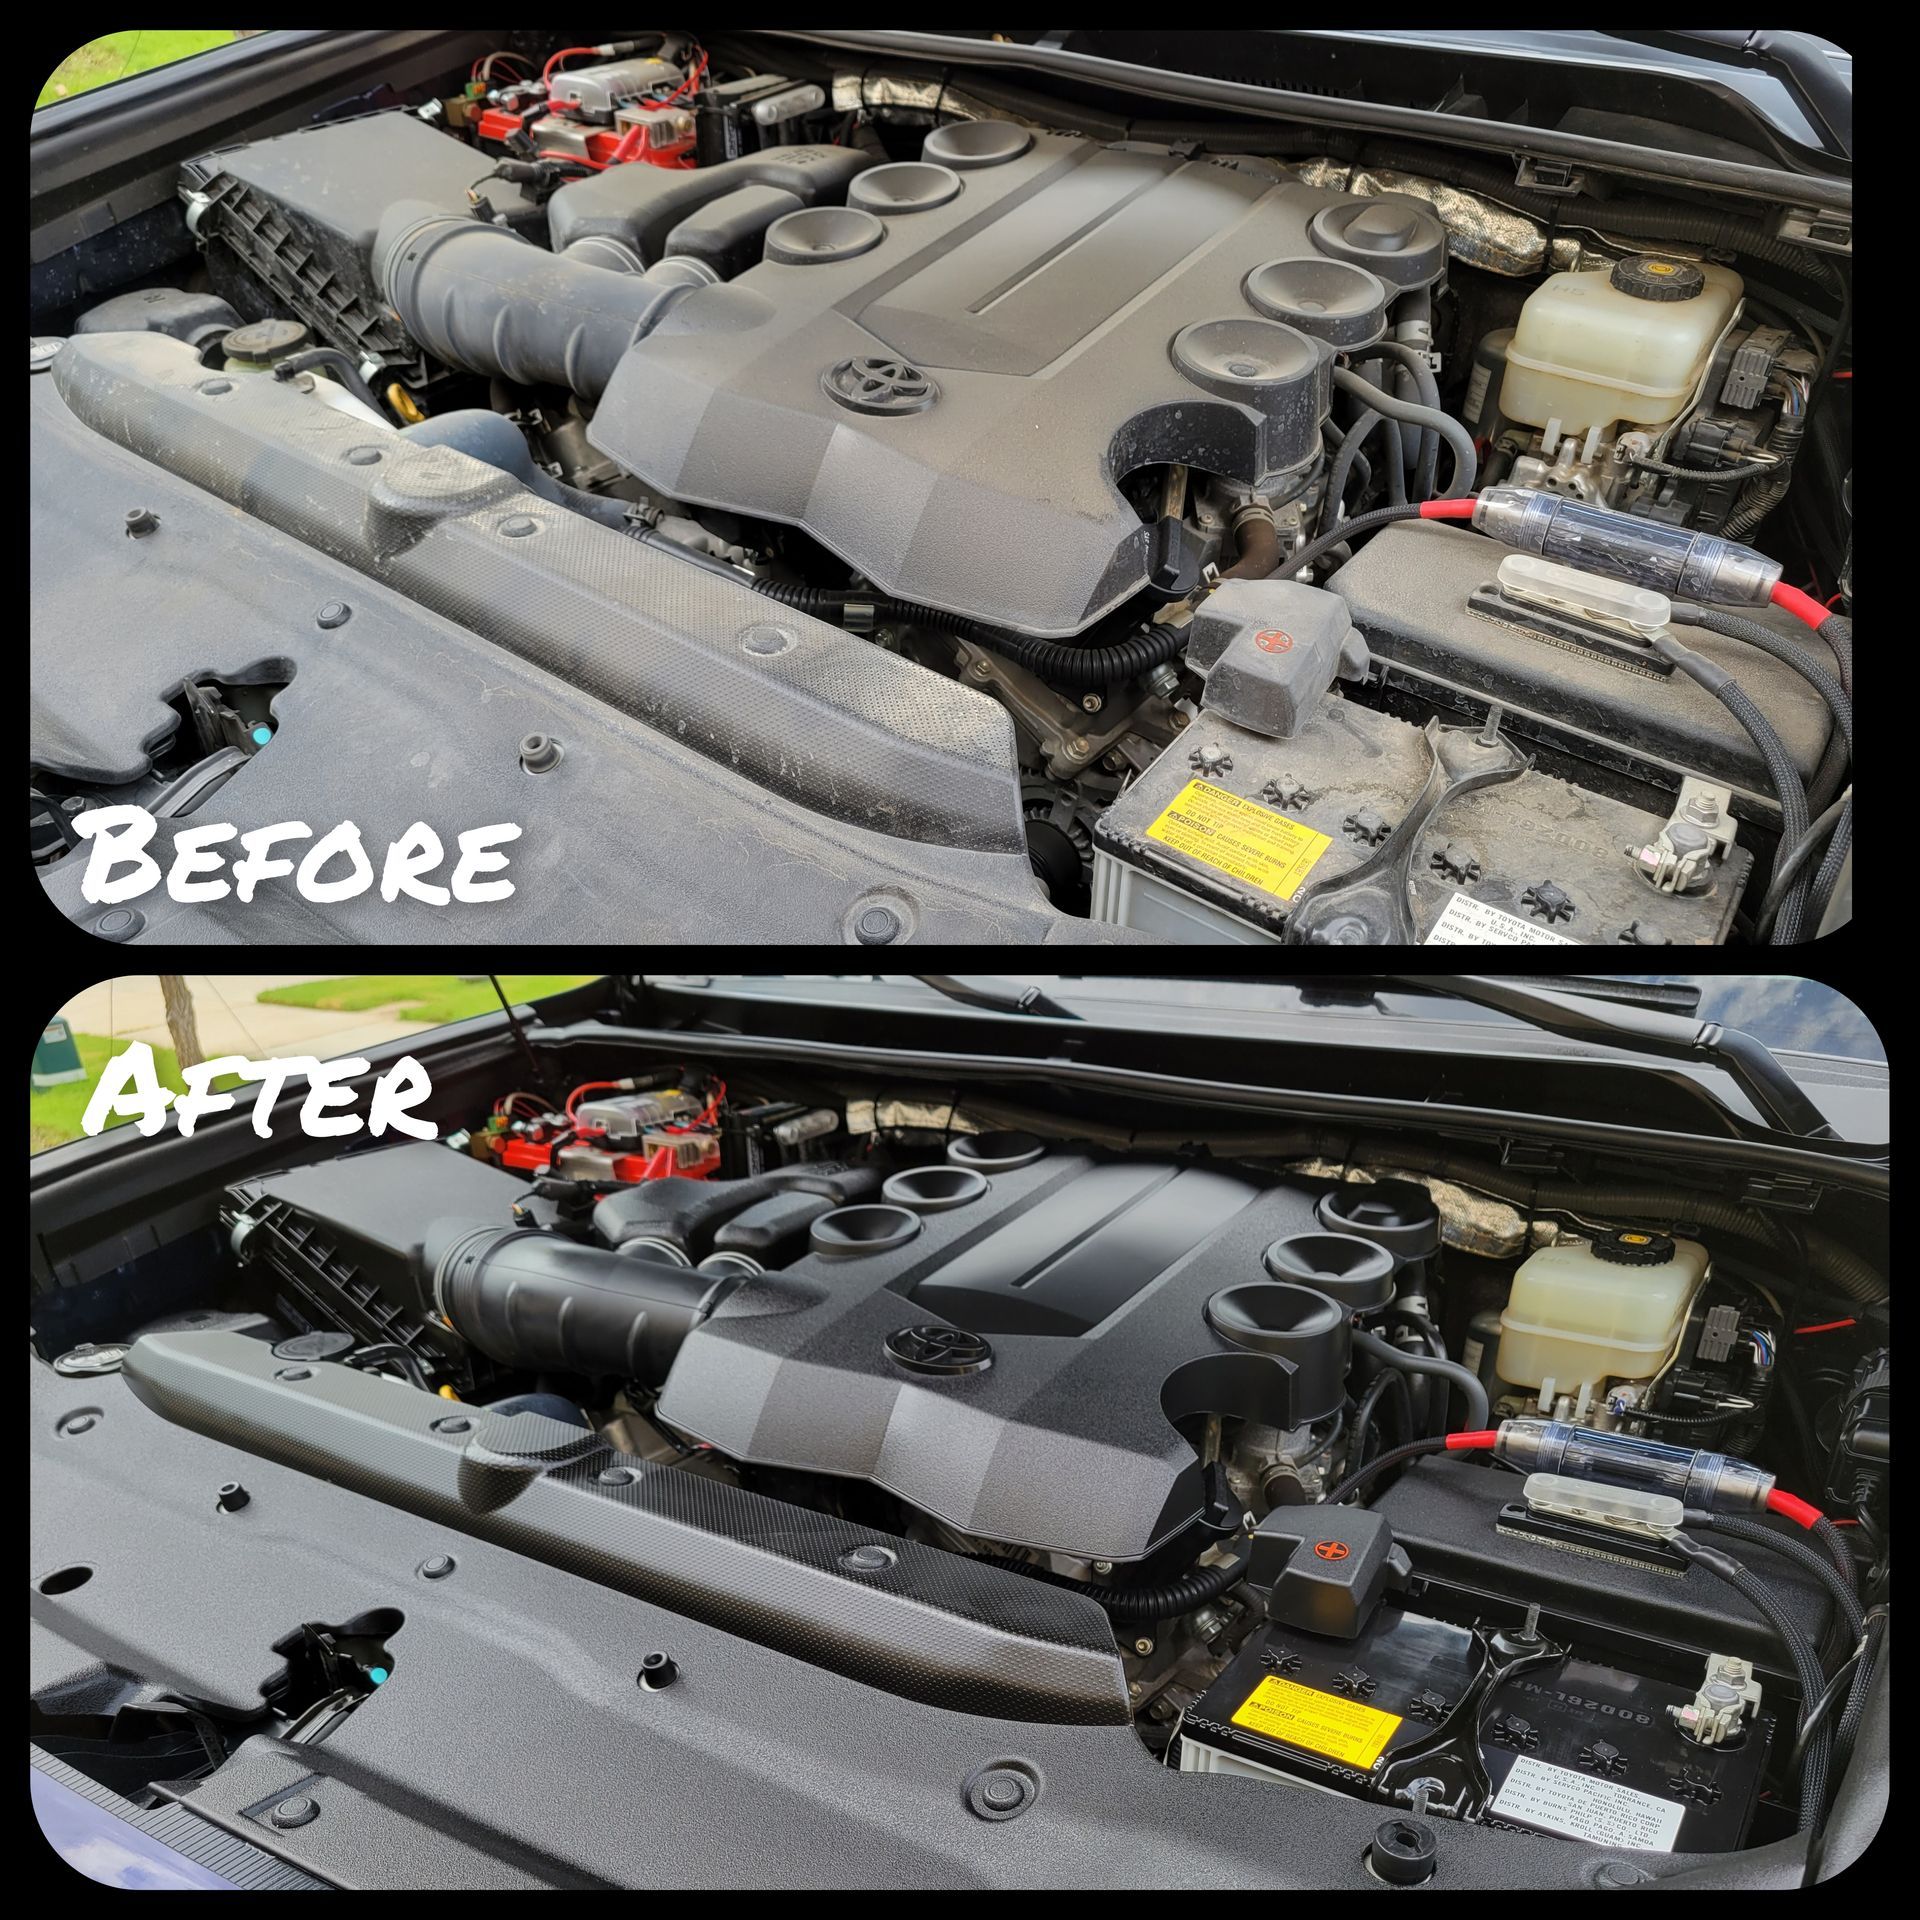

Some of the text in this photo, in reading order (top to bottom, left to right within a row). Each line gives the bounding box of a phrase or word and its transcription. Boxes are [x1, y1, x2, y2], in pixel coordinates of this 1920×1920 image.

[1196, 814, 1210, 824] NOT
[1212, 822, 1223, 830] TIP
[1203, 787, 1295, 830] DANGER EXPLOSIVE GASES
[1178, 816, 1213, 835] POISON
[1216, 833, 1240, 848] CAUSES
[1240, 845, 1264, 859] SEVERE
[1264, 855, 1286, 869] BURNS
[1163, 835, 1263, 886] KEEP OUT OF REACH OF CHILDREN
[1441, 922, 1465, 936] DISTR.
[1468, 933, 1478, 941] BY
[1448, 910, 1472, 923] DISTR.
[1475, 921, 1485, 929] BY
[1488, 926, 1517, 942] SERVCO
[1456, 897, 1480, 910] DISTR.
[1485, 909, 1494, 917] BY
[1498, 915, 1525, 930] TOYOTA
[1528, 928, 1554, 942] MOTOR
[1520, 1758, 1543, 1768] DISTR.
[1559, 1770, 1586, 1781] TOYOTA
[1588, 1779, 1614, 1790] MOTOR
[1552, 1779, 1581, 1791] SERVCO
[1582, 1789, 1612, 1801] PACIFIC
[1542, 1800, 1567, 1811] BURNS
[1569, 1808, 1592, 1819] PHILP
[1547, 1790, 1575, 1801] TOYOTA
[1588, 1802, 1616, 1814] PUERTO
[1619, 1812, 1638, 1822] RICO
[1639, 1818, 1661, 1829] CORP
[1566, 1802, 1582, 1810] SAN
[1608, 1814, 1638, 1828] PUERTO
[1640, 1824, 1659, 1834] RICO
[1635, 1811, 1663, 1823] HAWAII
[1568, 1814, 1590, 1825] PAGO
[1628, 1833, 1655, 1846] SAMOA
[1569, 1821, 1593, 1832] KROLL
